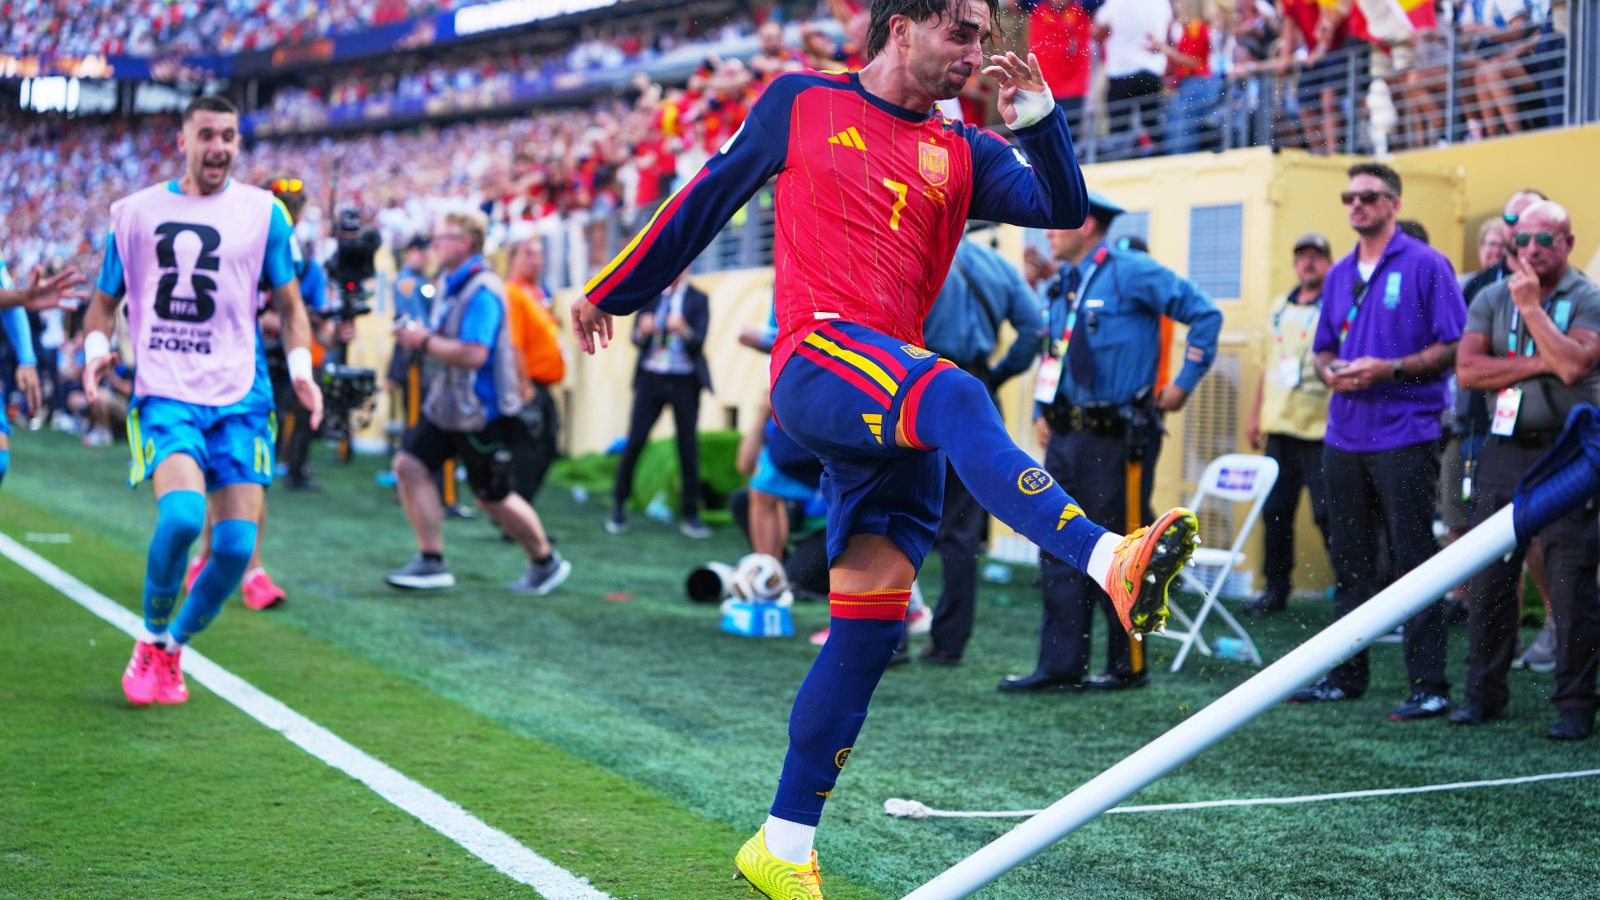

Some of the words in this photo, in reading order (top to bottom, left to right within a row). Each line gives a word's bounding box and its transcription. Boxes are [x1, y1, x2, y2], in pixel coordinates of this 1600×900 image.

[883, 177, 908, 231] 7
[169, 300, 200, 317] FIFA
[151, 325, 188, 336] WORLD
[190, 328, 212, 338] CUP
[149, 337, 211, 355] 2026
